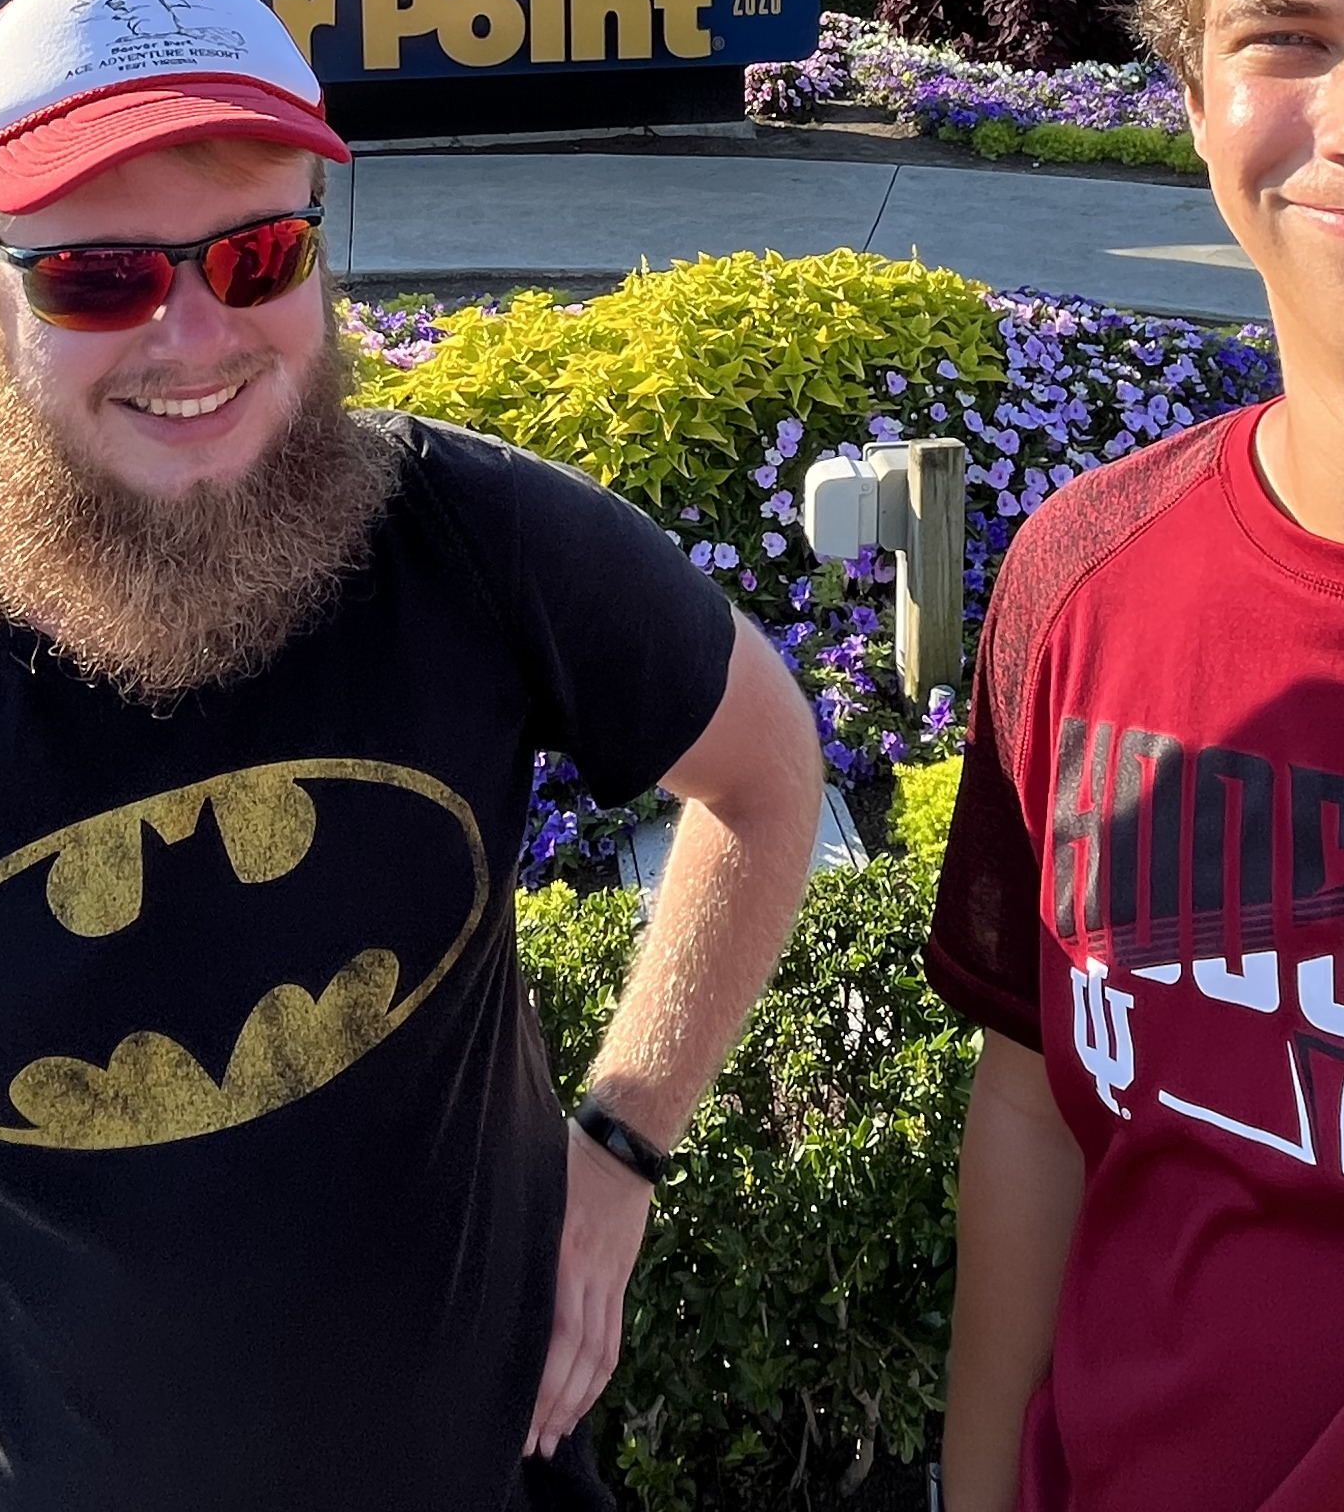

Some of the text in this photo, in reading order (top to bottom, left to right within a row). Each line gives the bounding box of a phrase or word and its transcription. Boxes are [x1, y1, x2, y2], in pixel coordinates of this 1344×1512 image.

[64, 47, 241, 81] ACE ADVENTURE RESORT
